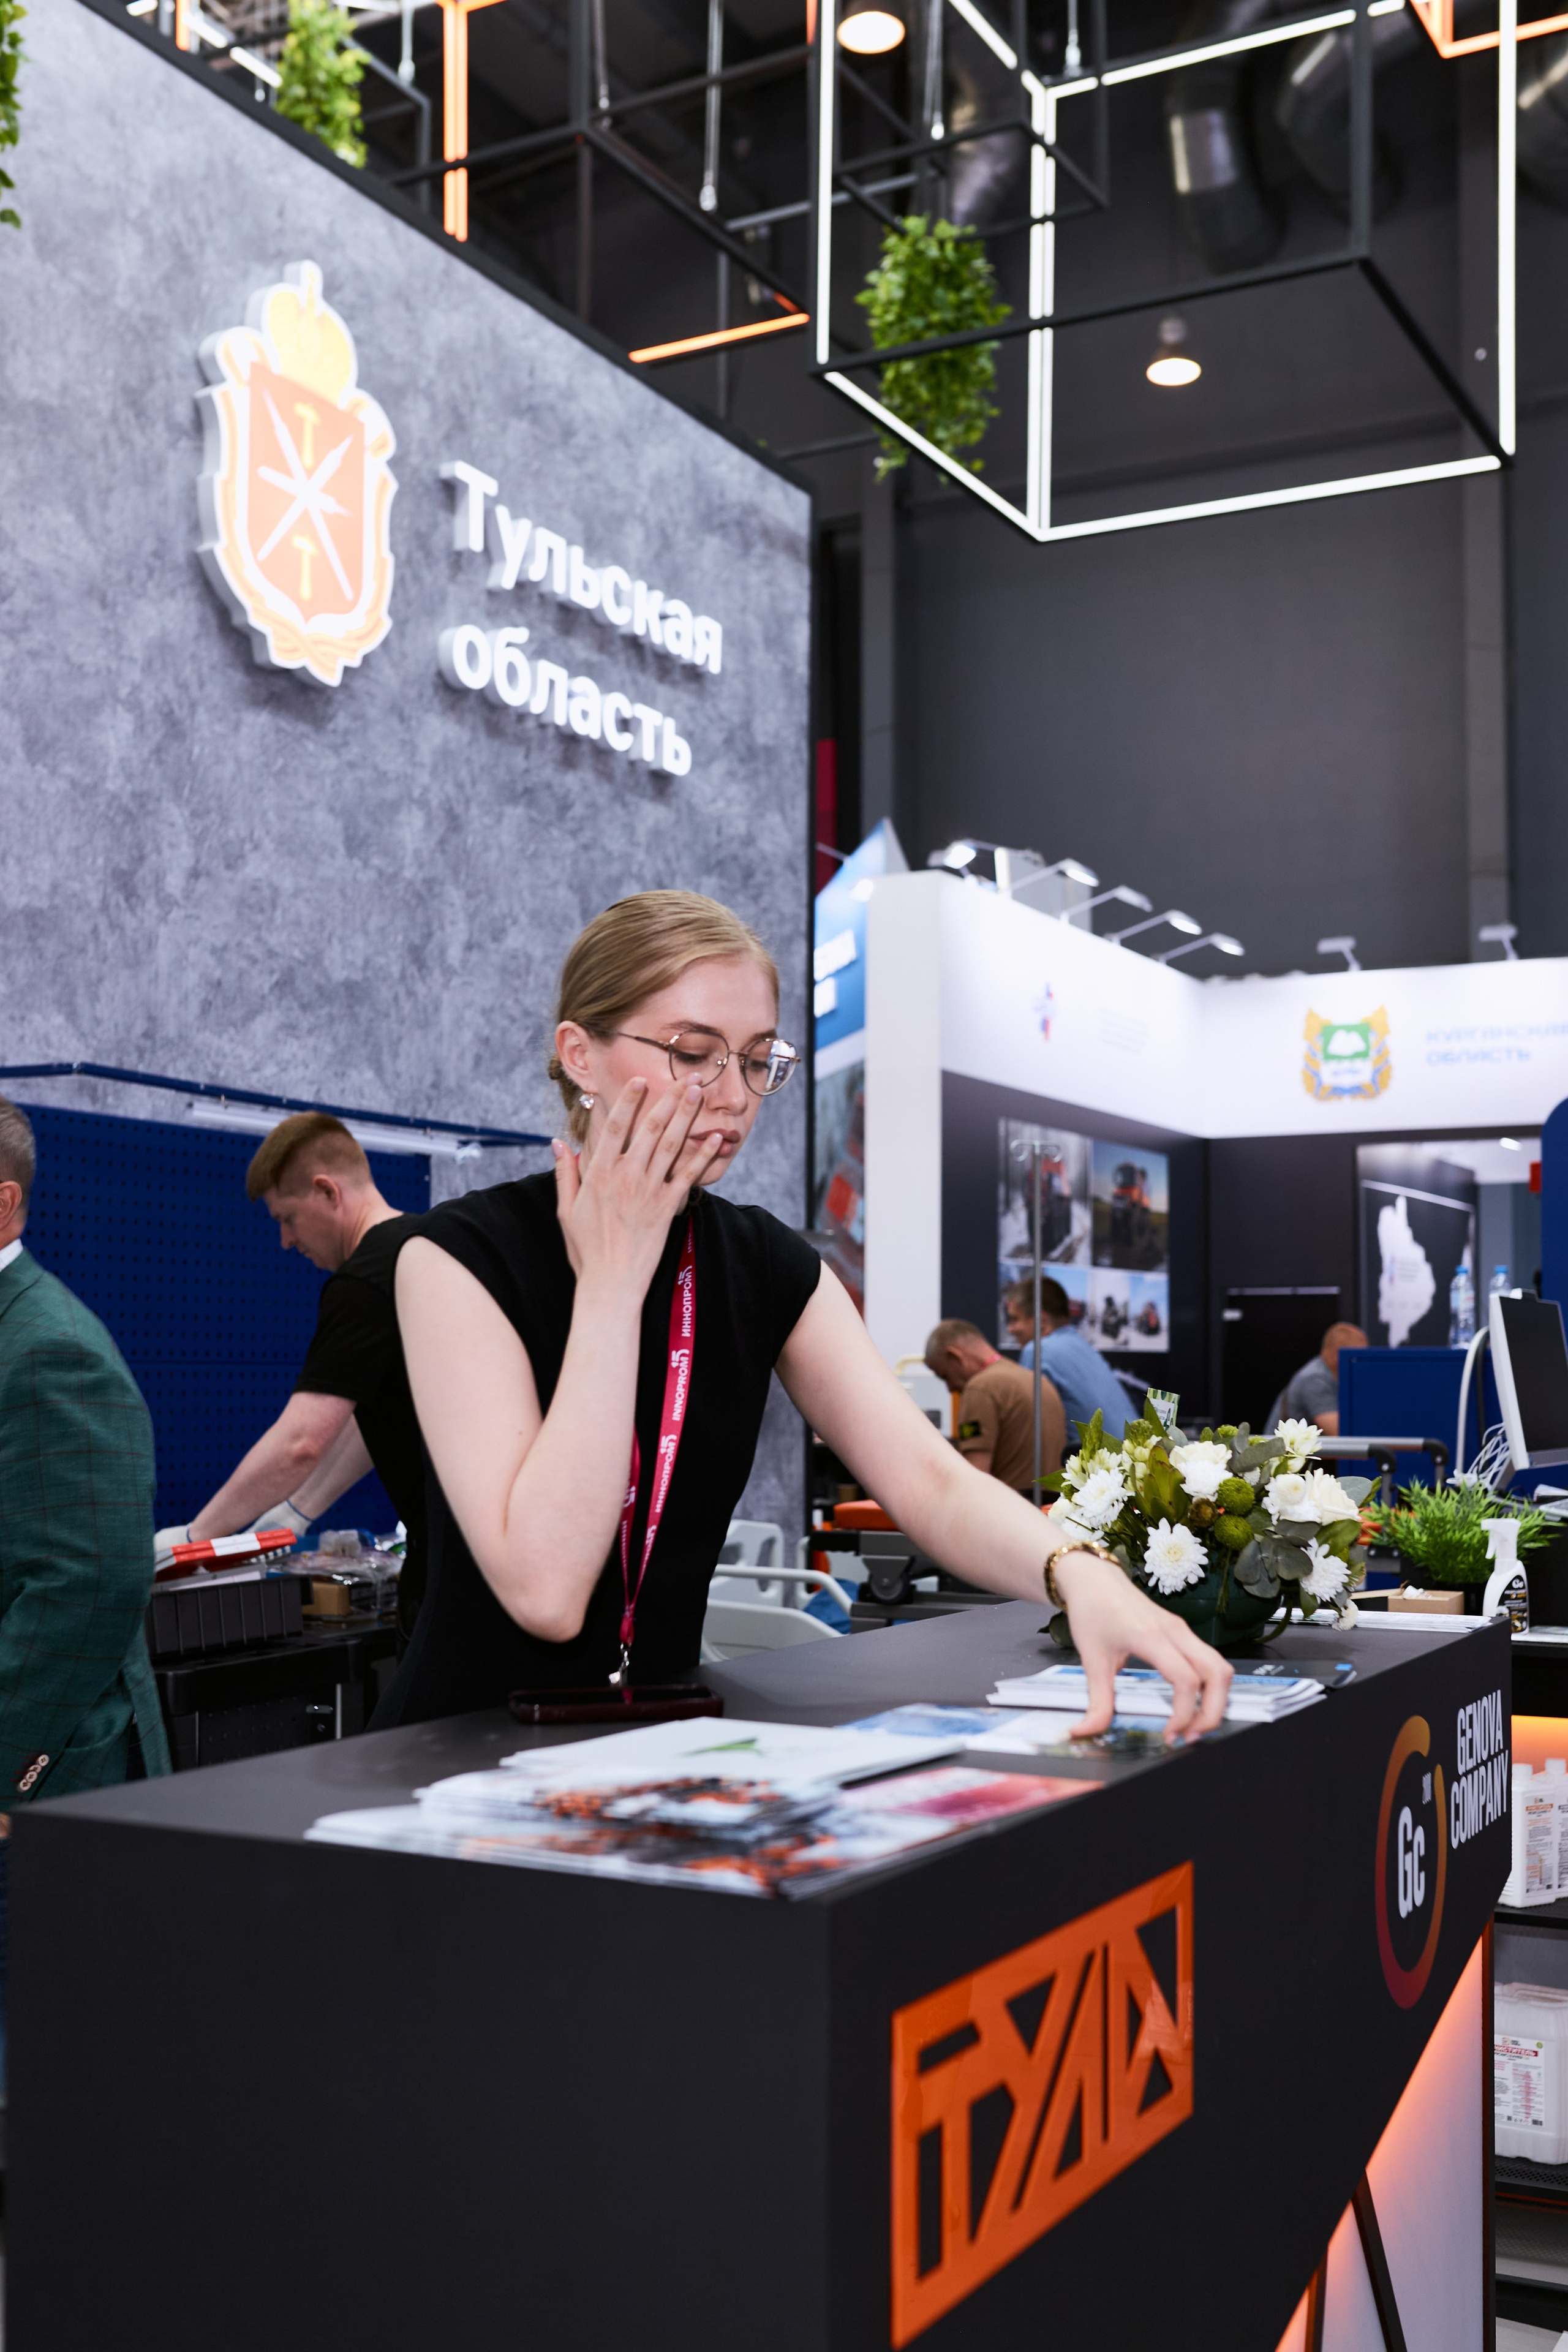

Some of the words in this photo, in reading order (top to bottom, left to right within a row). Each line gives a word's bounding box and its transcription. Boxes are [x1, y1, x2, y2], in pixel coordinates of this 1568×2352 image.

[444, 460, 723, 675] Тульская
[443, 624, 692, 777] область
[681, 1272, 693, 1337] ИННОПРОМ
[672, 1357, 688, 1421] INNOPROM
[655, 1441, 676, 1512] ИННОПРОМ
[1457, 1689, 1503, 1776] GENOVA
[1450, 1750, 1509, 1849] COMPANY
